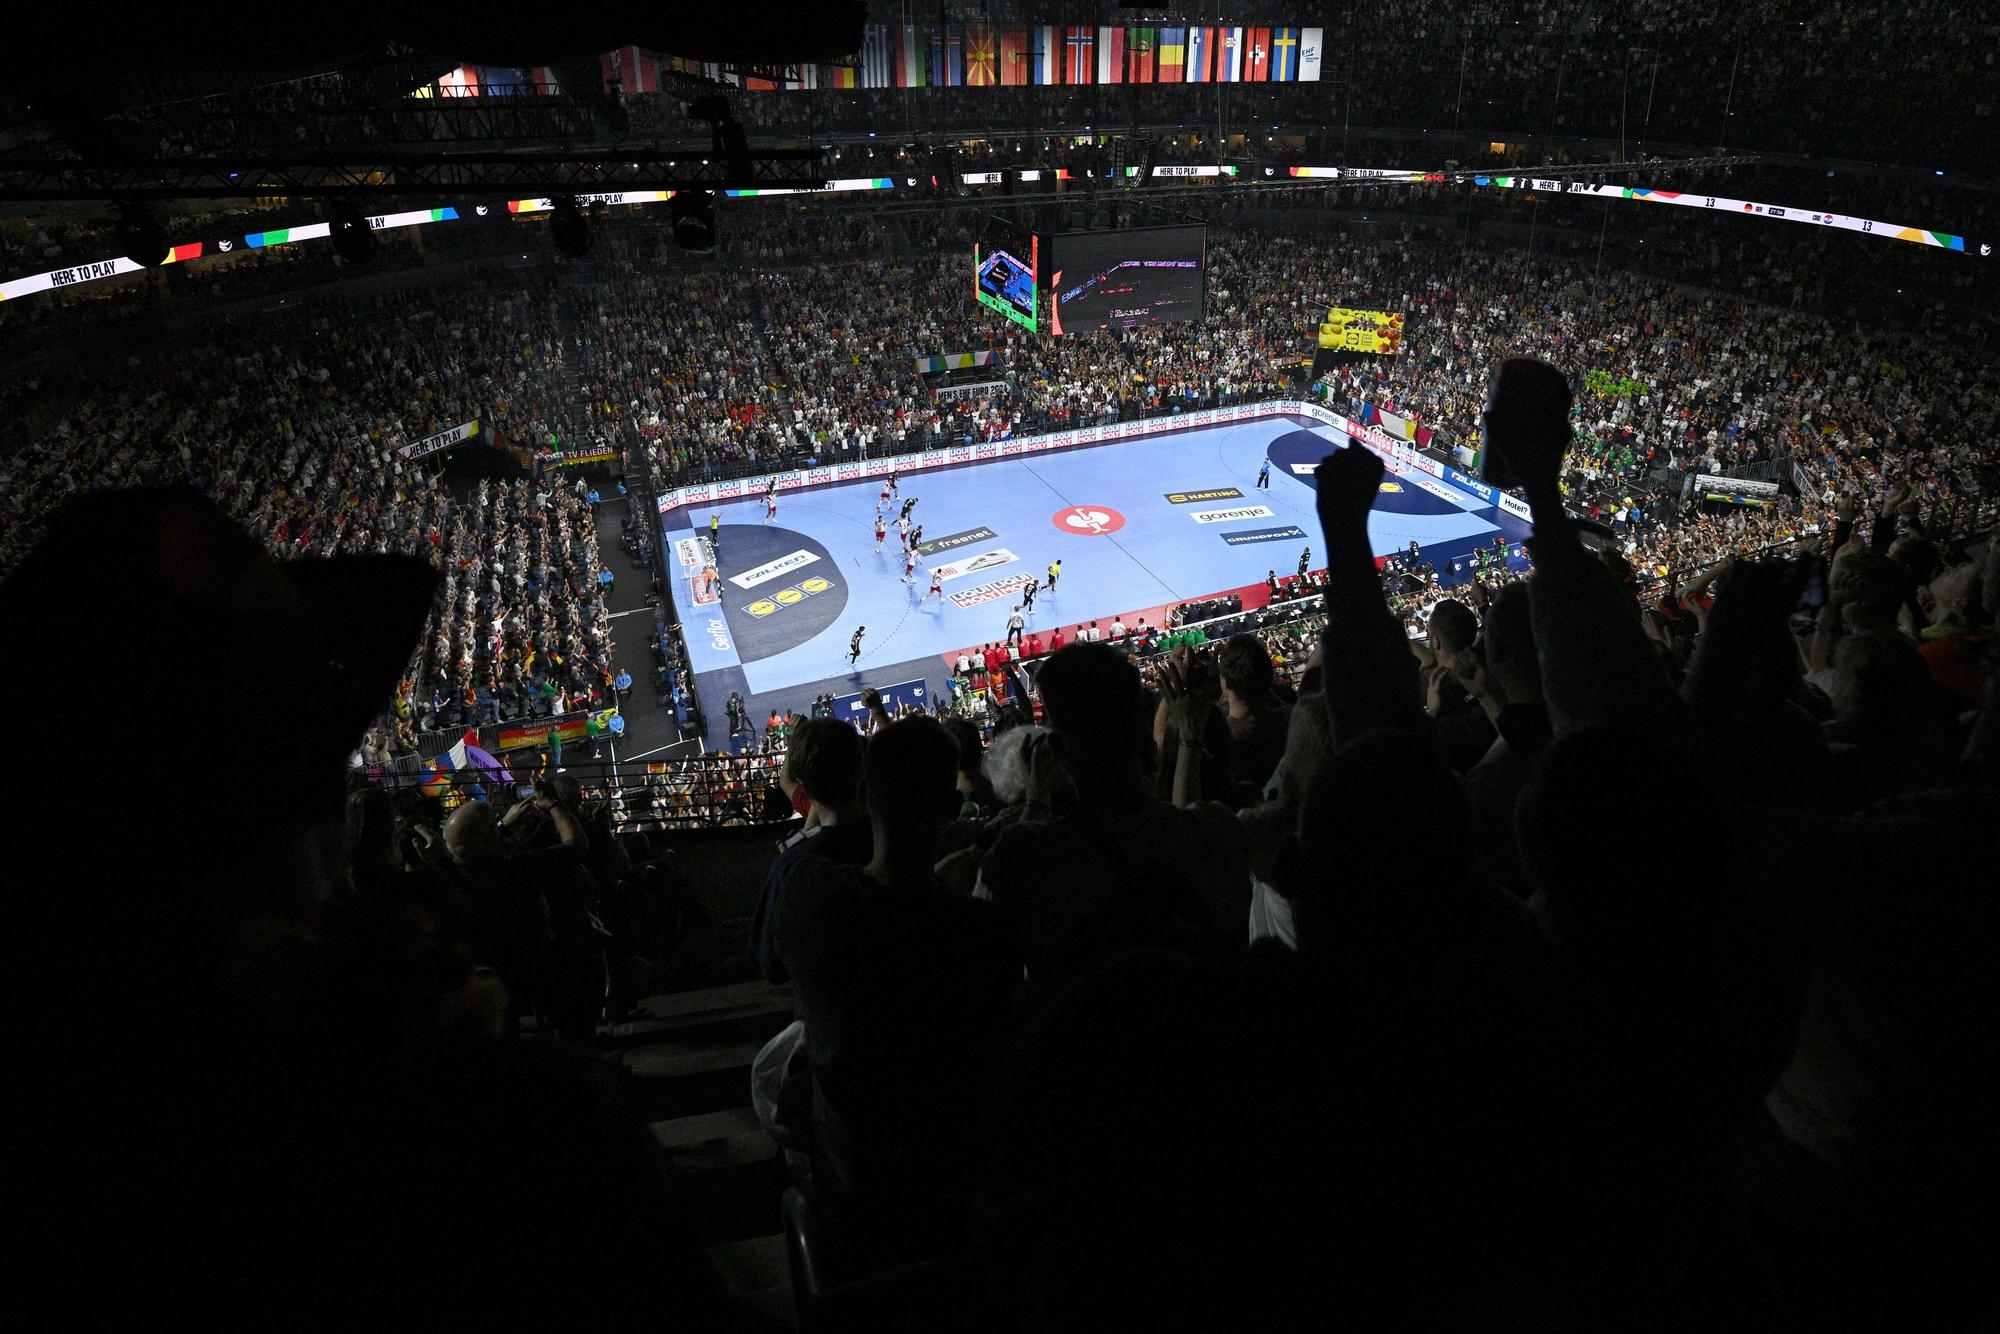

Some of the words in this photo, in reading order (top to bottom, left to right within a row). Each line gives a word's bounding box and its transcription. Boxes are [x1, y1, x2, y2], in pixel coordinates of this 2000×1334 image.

[1160, 167, 1174, 176] HERE
[1175, 167, 1183, 176] TO
[1183, 167, 1198, 176] PLAY
[1539, 180, 1555, 190] HERE
[604, 193, 624, 204] PLAY
[1705, 197, 1716, 208] 13
[1862, 220, 1873, 232] 13
[369, 216, 385, 229] LAY
[50, 268, 77, 287] HERE
[76, 265, 91, 281] TO
[91, 260, 116, 278] PLAY
[1311, 407, 1339, 425] gorenje
[409, 440, 431, 459] HERE
[430, 435, 442, 450] TO
[441, 428, 461, 446] PLAY
[976, 443, 996, 452] LIQUI
[580, 446, 613, 458] FLIEDEN
[923, 450, 943, 460] LIQUI
[950, 446, 970, 455] LIQUI
[976, 450, 996, 459] MOLY
[867, 459, 888, 468] LIQUI
[895, 455, 916, 464] LIQUI
[923, 458, 943, 467] MOLY
[950, 454, 971, 463] MOLY
[838, 463, 859, 473] LIQUI
[867, 466, 888, 476] MOLY
[895, 462, 917, 471] MOLY
[779, 472, 801, 481] LIQUI
[809, 467, 830, 477] LIQUI
[838, 470, 861, 480] MOLY
[748, 476, 771, 486] LIQUI
[779, 480, 803, 489] MOLY
[809, 475, 832, 485] MOLY
[686, 485, 709, 495] LIQUI
[717, 481, 740, 491] LIQUI
[660, 491, 678, 504] LIQUI
[686, 493, 710, 504] MOLY
[718, 489, 741, 499] MOLY
[1188, 489, 1239, 500] HARTING
[659, 499, 679, 513] MOLY
[1504, 498, 1528, 515] Hotel?
[1199, 507, 1265, 522] gorenje
[938, 529, 993, 548] freenet
[1227, 531, 1290, 543] GRUNDFOS
[991, 573, 1034, 588] LIQUI
[951, 583, 992, 601] LIQUI
[958, 590, 999, 608] MOLY
[706, 618, 730, 651] Gerflor
